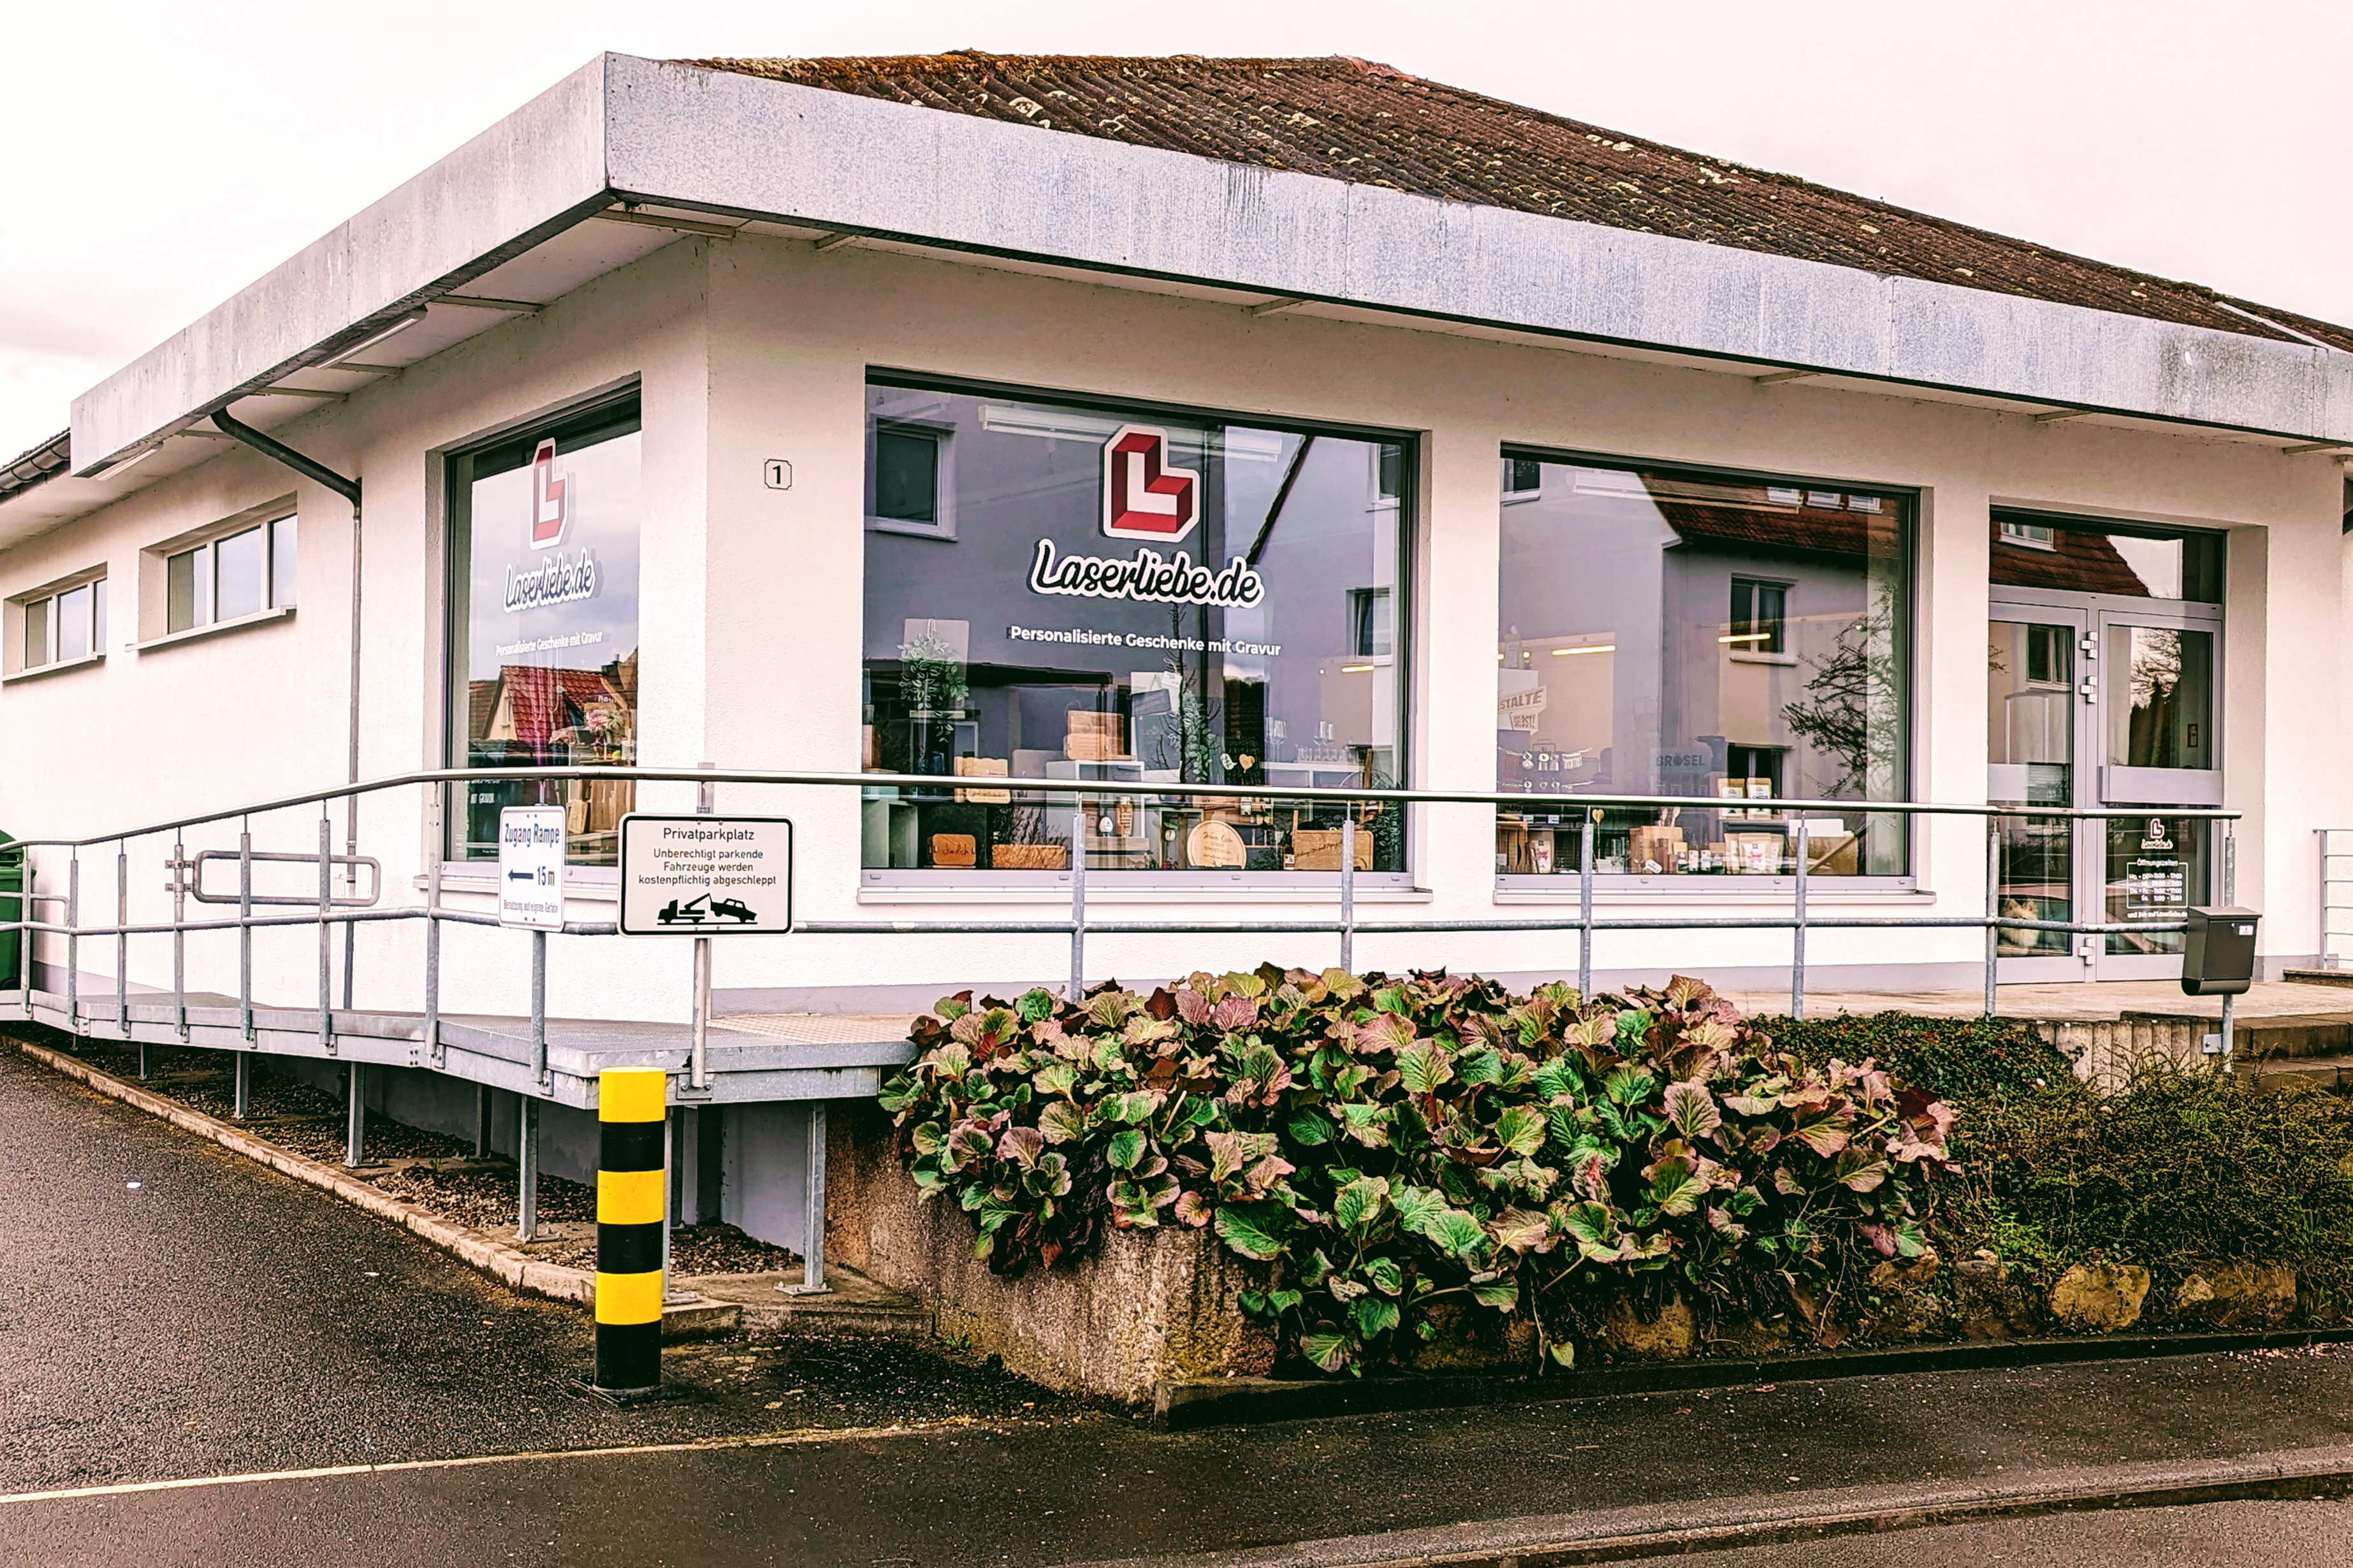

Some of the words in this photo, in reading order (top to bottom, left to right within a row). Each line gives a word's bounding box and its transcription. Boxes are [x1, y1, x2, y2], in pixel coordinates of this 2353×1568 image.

[773, 465, 780, 484] 1
[504, 549, 594, 611] Laserliebe.de
[1033, 541, 1263, 606] Laserliebe.de
[496, 639, 536, 656] Personalisierte
[537, 634, 569, 651] Geschenke
[569, 632, 581, 646] mit
[581, 631, 603, 644] Gravur
[1010, 625, 1122, 646] Personalisierte
[1125, 632, 1205, 651] Geschenke
[1207, 639, 1232, 653] mit
[1235, 641, 1281, 656] Gravur
[505, 823, 532, 847] Zugang
[534, 823, 560, 848] Rampe
[663, 827, 755, 843] Privatparkplatz
[653, 848, 716, 861] Unberechtigt
[718, 850, 764, 860] parkende
[537, 866, 546, 886] 15
[548, 871, 555, 886] m
[664, 862, 715, 873] Fahrzeuge
[718, 862, 754, 871] werden
[639, 875, 710, 887] kostenpflichtig
[713, 875, 776, 887] abgeschleppt
